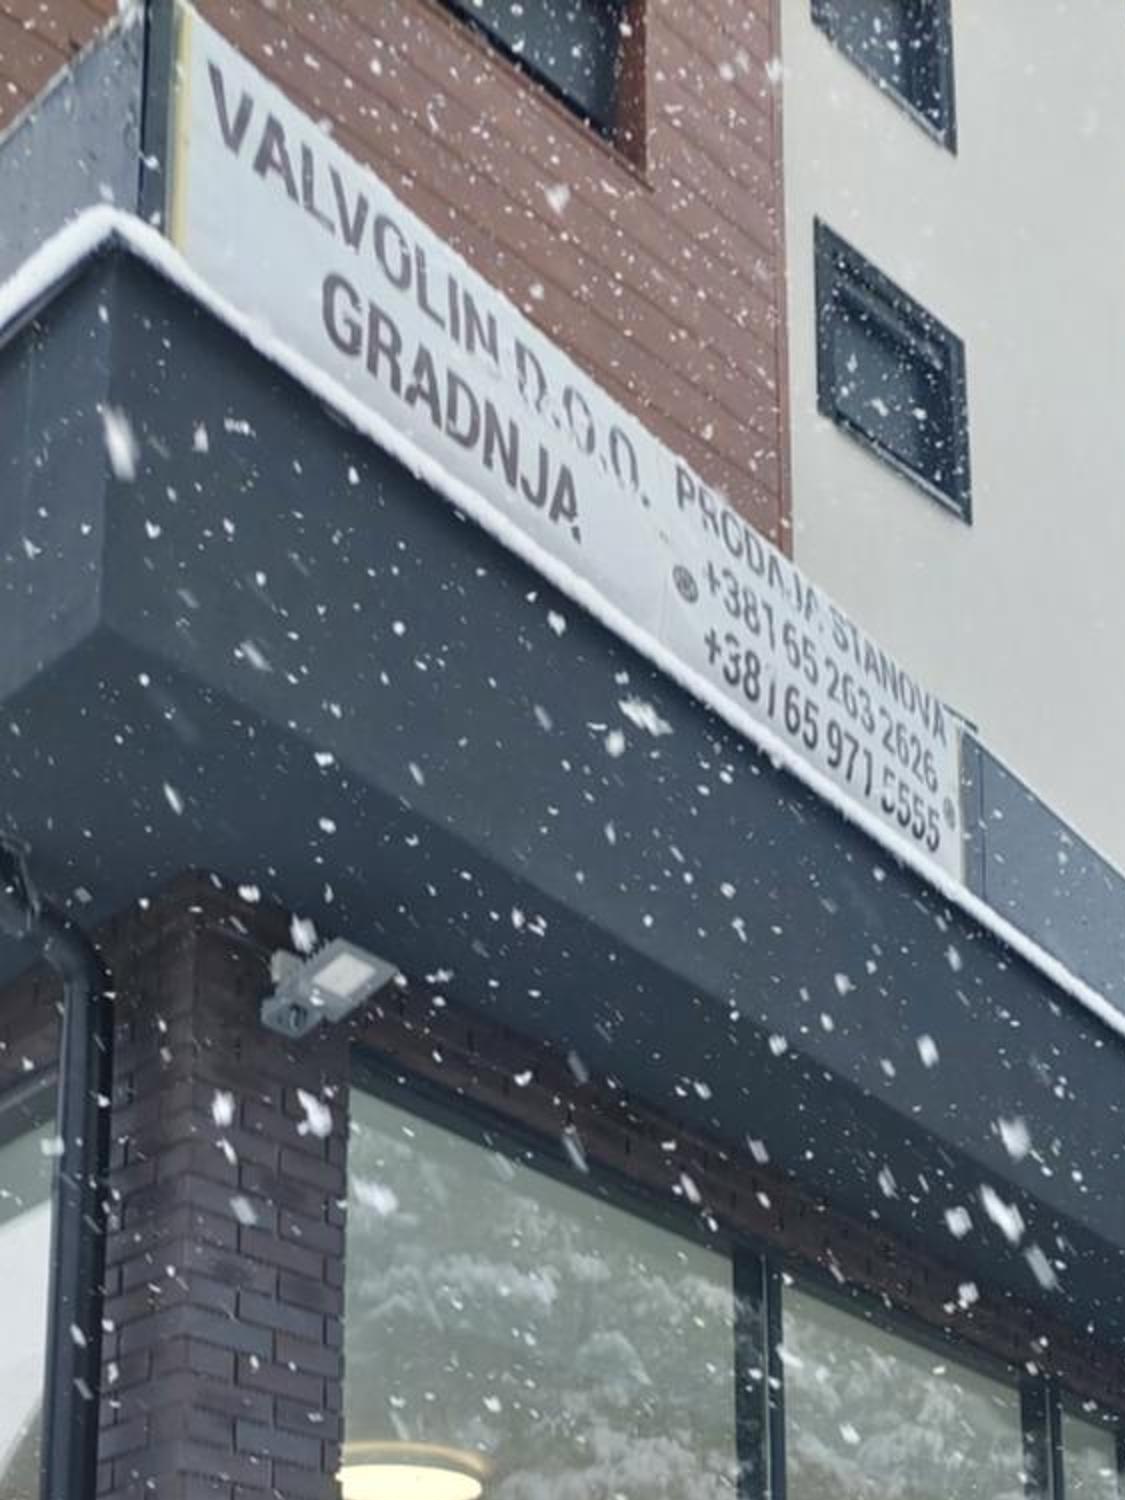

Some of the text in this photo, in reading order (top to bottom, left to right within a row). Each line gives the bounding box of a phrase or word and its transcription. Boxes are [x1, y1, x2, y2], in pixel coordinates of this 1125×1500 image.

[206, 60, 500, 366] VALVOLIN
[321, 272, 581, 543] GRADNJA
[703, 561, 938, 798] +381 65 263 2626
[784, 684, 819, 750] 65
[827, 719, 872, 797] 971
[880, 763, 940, 853] 5555
[828, 603, 948, 749] STANOVA
